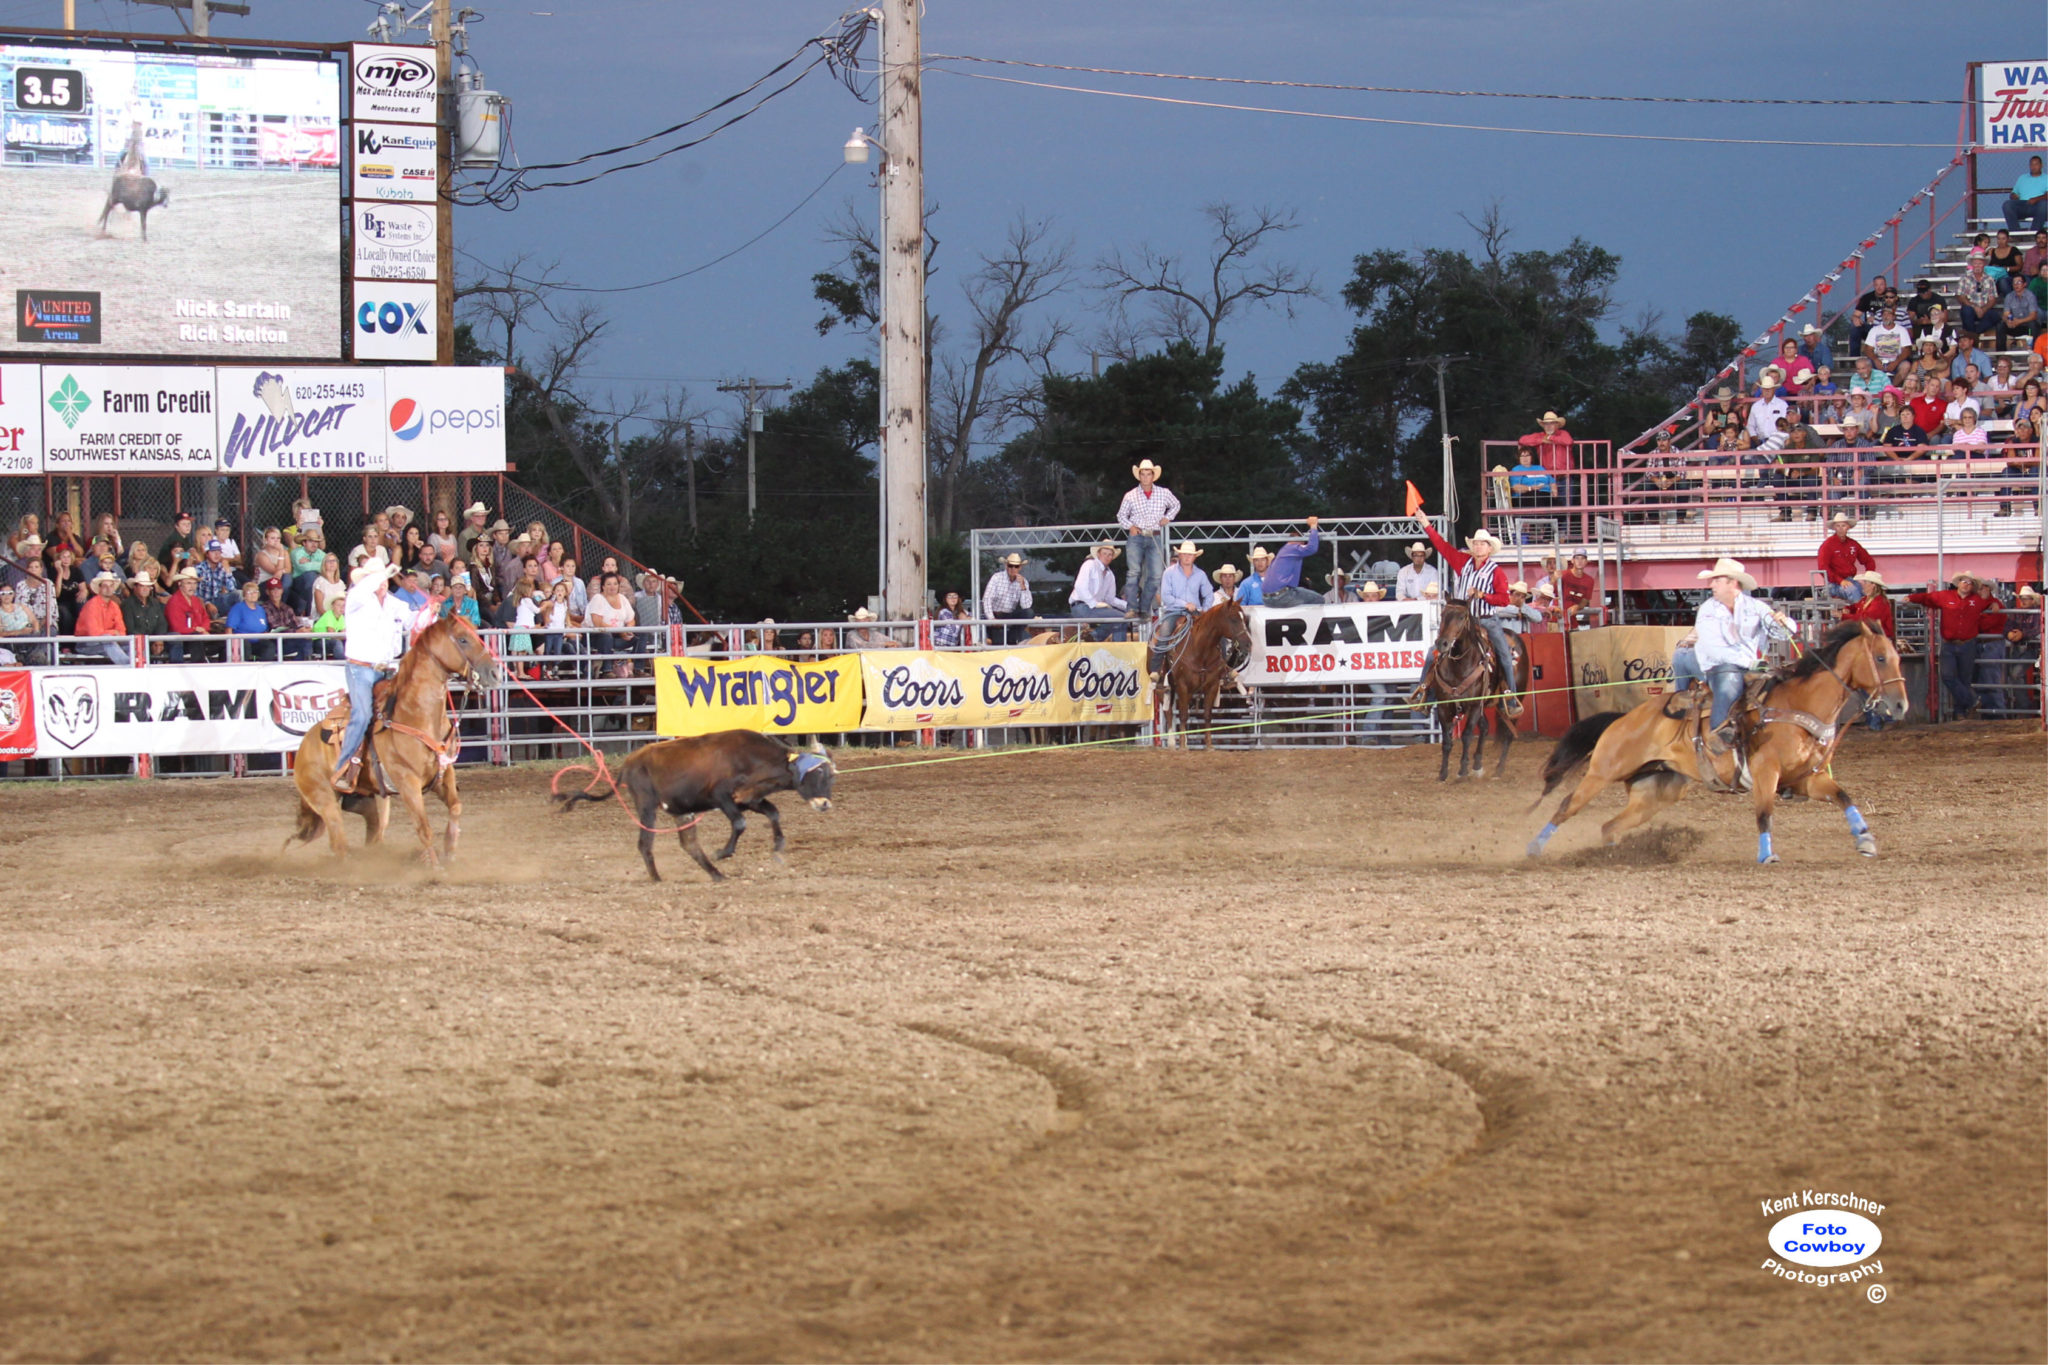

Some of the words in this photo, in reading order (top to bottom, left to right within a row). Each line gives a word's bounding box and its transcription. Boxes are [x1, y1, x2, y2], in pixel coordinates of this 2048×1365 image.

[365, 61, 419, 87] mje
[24, 76, 70, 106] 3.5
[356, 86, 371, 95] Max
[372, 87, 392, 97] Jantz
[393, 88, 435, 102] Excavating
[1989, 88, 2048, 122] Tru
[382, 135, 436, 150] KanEquip
[1992, 123, 2047, 144] HAR
[403, 168, 426, 176] CASE
[376, 186, 414, 199] Kubota
[388, 221, 412, 231] Waste
[363, 247, 387, 264] Locally
[389, 248, 411, 262] Owned
[413, 249, 436, 263] Choice
[371, 265, 426, 279] 620-225-6580
[42, 300, 92, 314] UNITED
[176, 300, 218, 318] Nick
[223, 301, 290, 320] Sartain
[43, 314, 92, 323] WIRELESS
[358, 301, 431, 341] COX
[43, 328, 79, 340] Arena
[179, 324, 217, 341] Rich
[223, 326, 288, 343] Skelton
[103, 390, 149, 413] Farm
[157, 390, 211, 413] Credit
[296, 384, 365, 400] 620-255-4453
[430, 404, 500, 434] pepsi
[80, 433, 115, 446] FARM
[119, 433, 161, 446] CREDIT
[166, 433, 182, 446] OF
[224, 404, 356, 468] WILDCAT
[0, 456, 33, 470] -2108
[50, 448, 124, 461] SOUTHWEST
[129, 448, 184, 462] KANSAS,
[188, 449, 212, 462] ACA
[278, 452, 366, 468] ELECTRIC
[1265, 614, 1423, 646] RAM
[1266, 653, 1335, 673] RODEO
[1351, 650, 1425, 670] SERIES
[882, 665, 964, 708] Coors
[981, 664, 1051, 705] Coors
[1068, 657, 1138, 700] Coors
[673, 664, 839, 727] Wrangler
[114, 689, 258, 723] RAM
